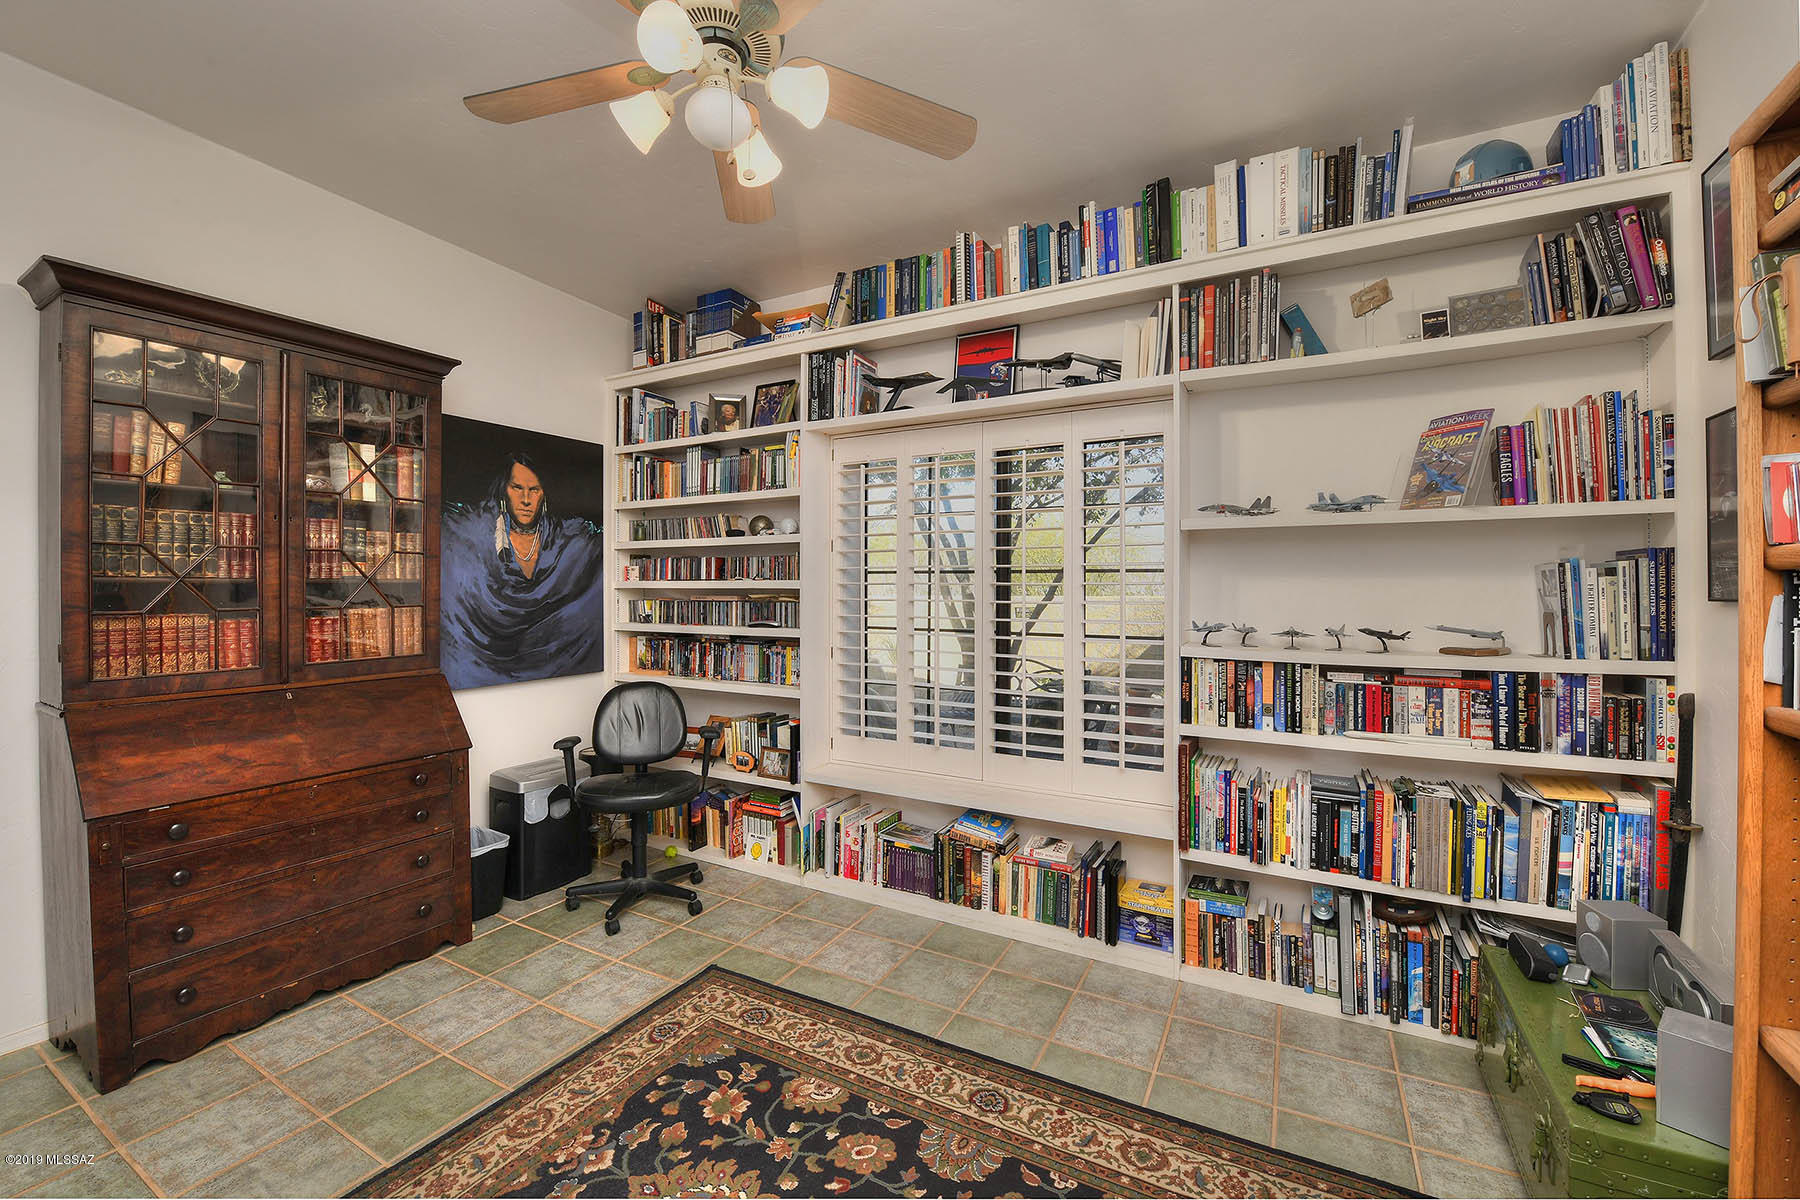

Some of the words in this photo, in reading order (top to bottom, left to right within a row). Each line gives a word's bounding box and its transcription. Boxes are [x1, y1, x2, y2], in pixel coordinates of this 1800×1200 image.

[1649, 89, 1659, 133] AVIATION
[1415, 197, 1453, 209] HAMMOND
[1473, 186, 1503, 198] WORLD
[1504, 179, 1540, 192] HISTORY
[1550, 243, 1558, 257] JOHN
[1607, 224, 1620, 249] FULL
[1616, 251, 1633, 287] MOON
[1551, 257, 1560, 276] GLENN
[1568, 250, 1576, 275] Colonies
[647, 300, 664, 314] LIFE
[1605, 391, 1614, 417] SOVIET
[1430, 415, 1466, 429] AVIATION
[1465, 412, 1489, 421] WEEK
[1607, 418, 1616, 443] WINGS
[1422, 432, 1478, 452] AIRCRAFT
[1499, 435, 1509, 452] RED
[1500, 453, 1511, 483] EAGLES
[1587, 583, 1595, 611] FIGHTER
[1588, 611, 1596, 638] COMBAT
[1499, 673, 1508, 685] Tom
[1518, 674, 1527, 685] The
[1589, 676, 1601, 687] RED
[1497, 686, 1508, 704] Clancy
[1518, 685, 1527, 699] Bear
[1518, 700, 1527, 711] and
[1589, 688, 1601, 717] NOVEMBER
[1499, 706, 1508, 719] Debt
[1518, 712, 1527, 722] The
[1499, 727, 1508, 745] Honor
[1518, 723, 1527, 743] Dragon
[1656, 735, 1666, 751] SSN
[1352, 810, 1360, 834] BUTTON
[1590, 812, 1598, 824] Gulf
[1375, 802, 1383, 853] DREADNOUGHT
[1351, 853, 1359, 868] FORD
[1656, 833, 1671, 890] WARPLANES
[1127, 901, 1142, 909] STAR
[1143, 904, 1173, 915] THEATER
